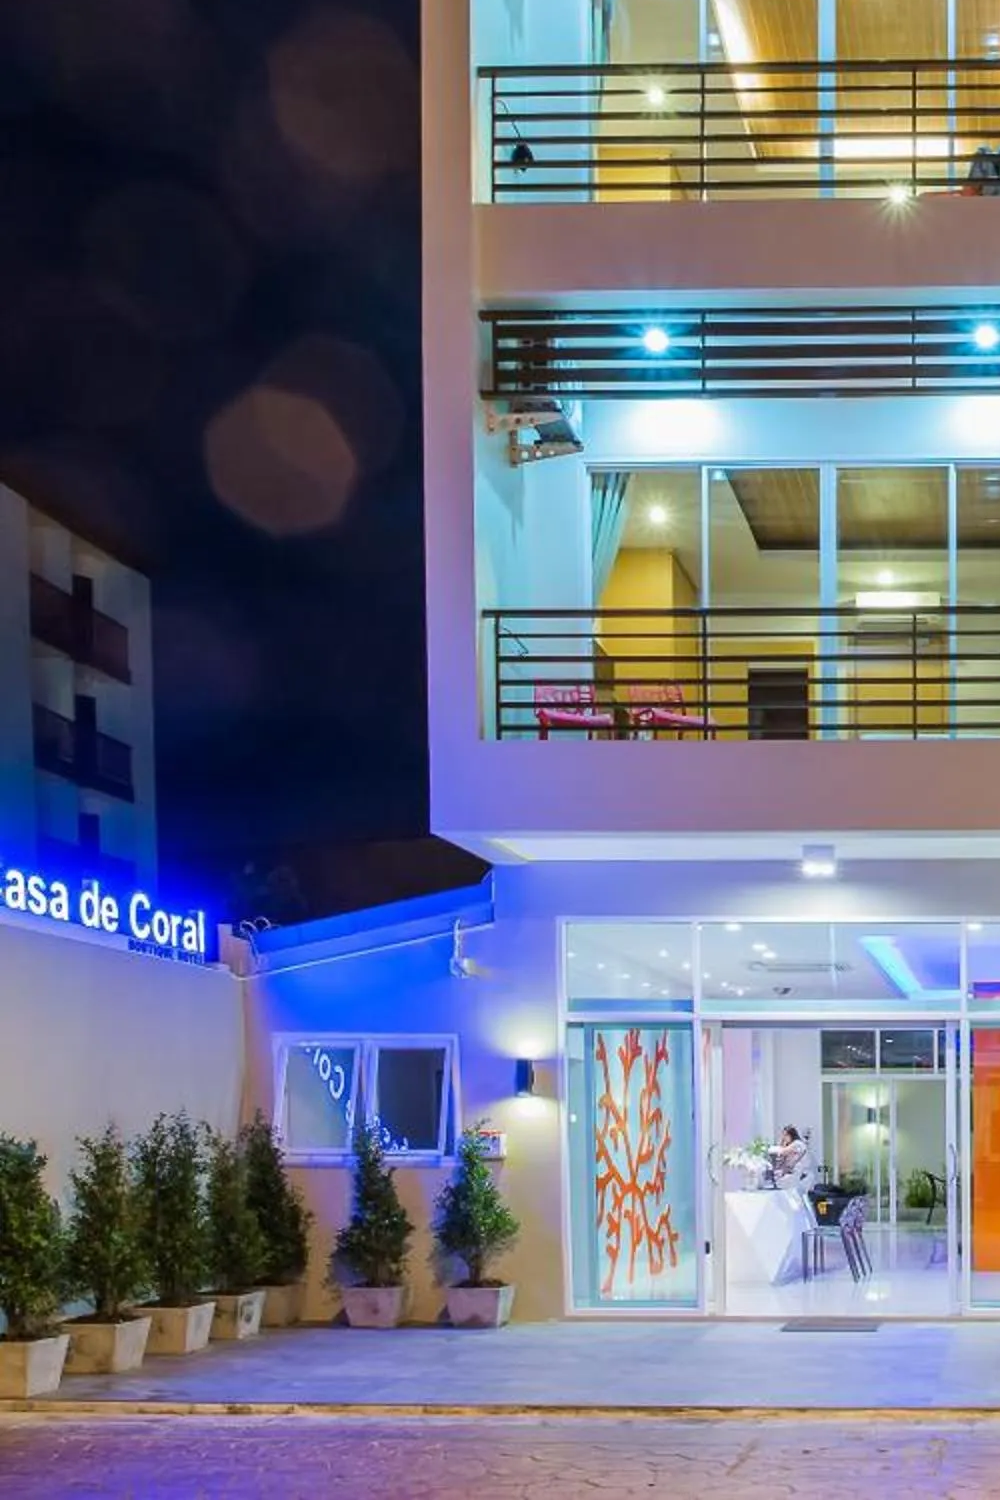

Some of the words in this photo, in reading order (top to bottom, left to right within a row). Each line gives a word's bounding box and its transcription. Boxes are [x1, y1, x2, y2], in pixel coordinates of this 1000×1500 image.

[0, 869, 69, 921] asa
[79, 879, 119, 932] de
[129, 892, 205, 953] Coral
